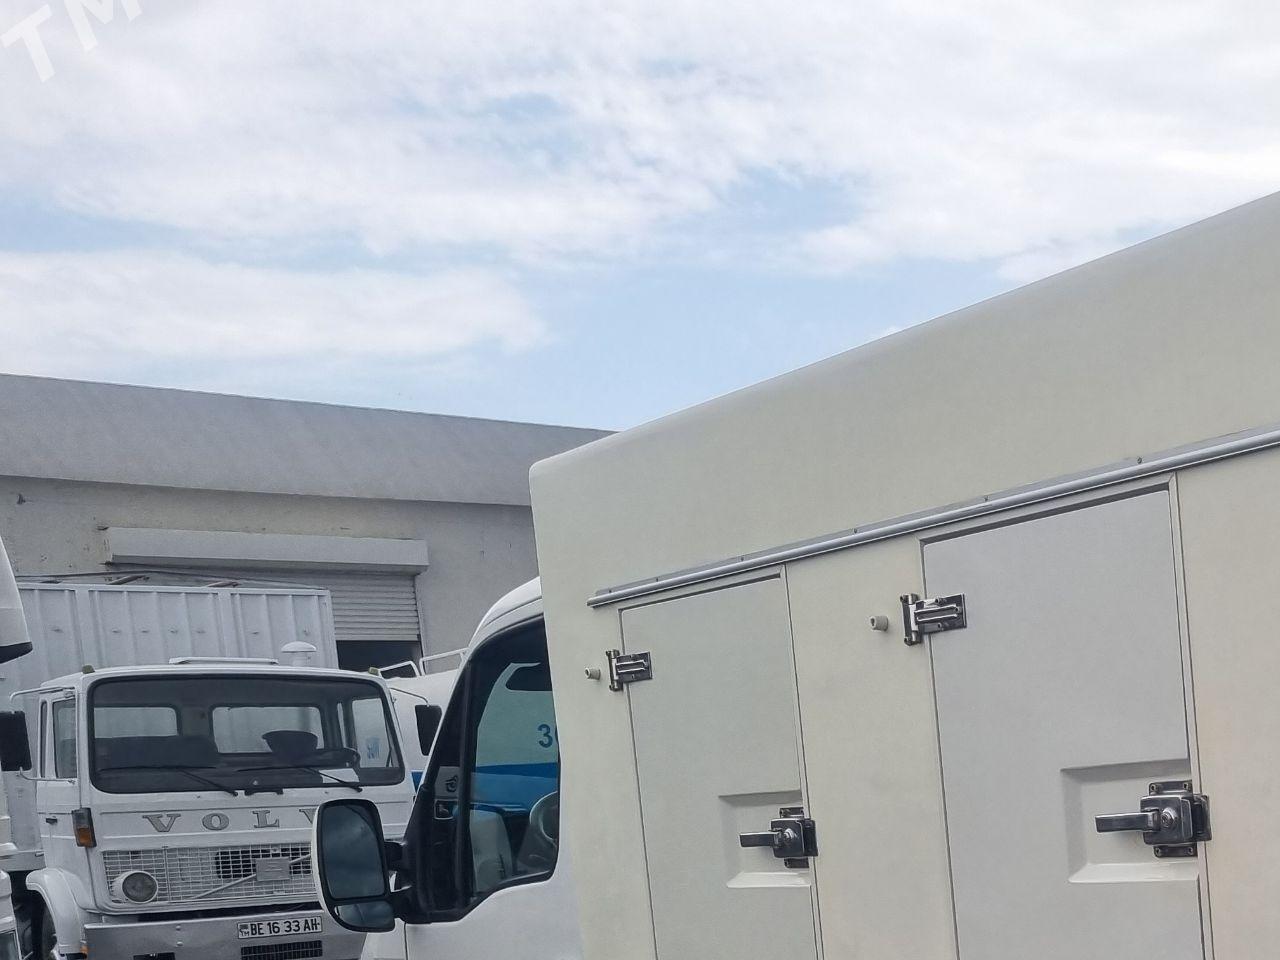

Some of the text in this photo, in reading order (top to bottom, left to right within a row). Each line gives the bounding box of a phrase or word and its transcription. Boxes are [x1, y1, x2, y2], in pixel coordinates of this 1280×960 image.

[250, 918, 318, 936] BE 16 33 AH
